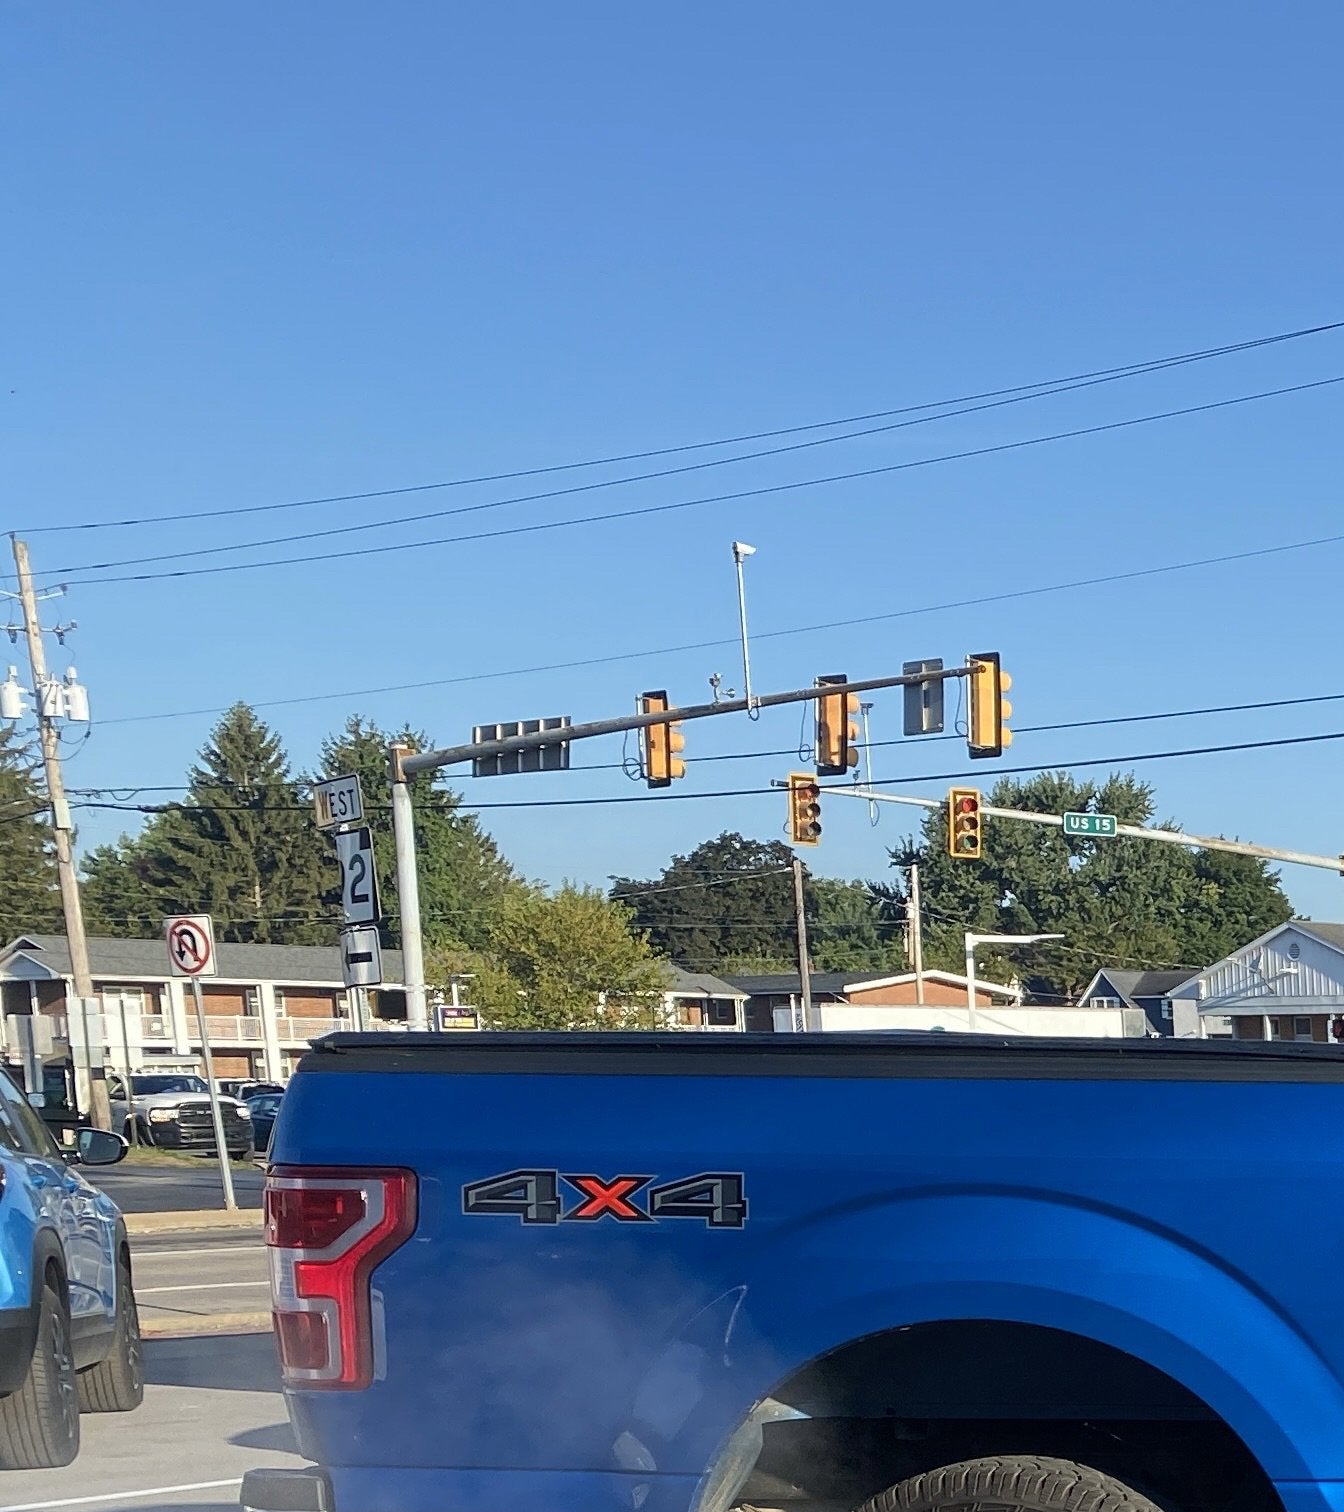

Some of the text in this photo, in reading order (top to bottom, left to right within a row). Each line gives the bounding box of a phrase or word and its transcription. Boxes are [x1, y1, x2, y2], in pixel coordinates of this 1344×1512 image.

[317, 789, 355, 820] WEST
[1070, 817, 1111, 831] US 15
[348, 854, 370, 904] 2
